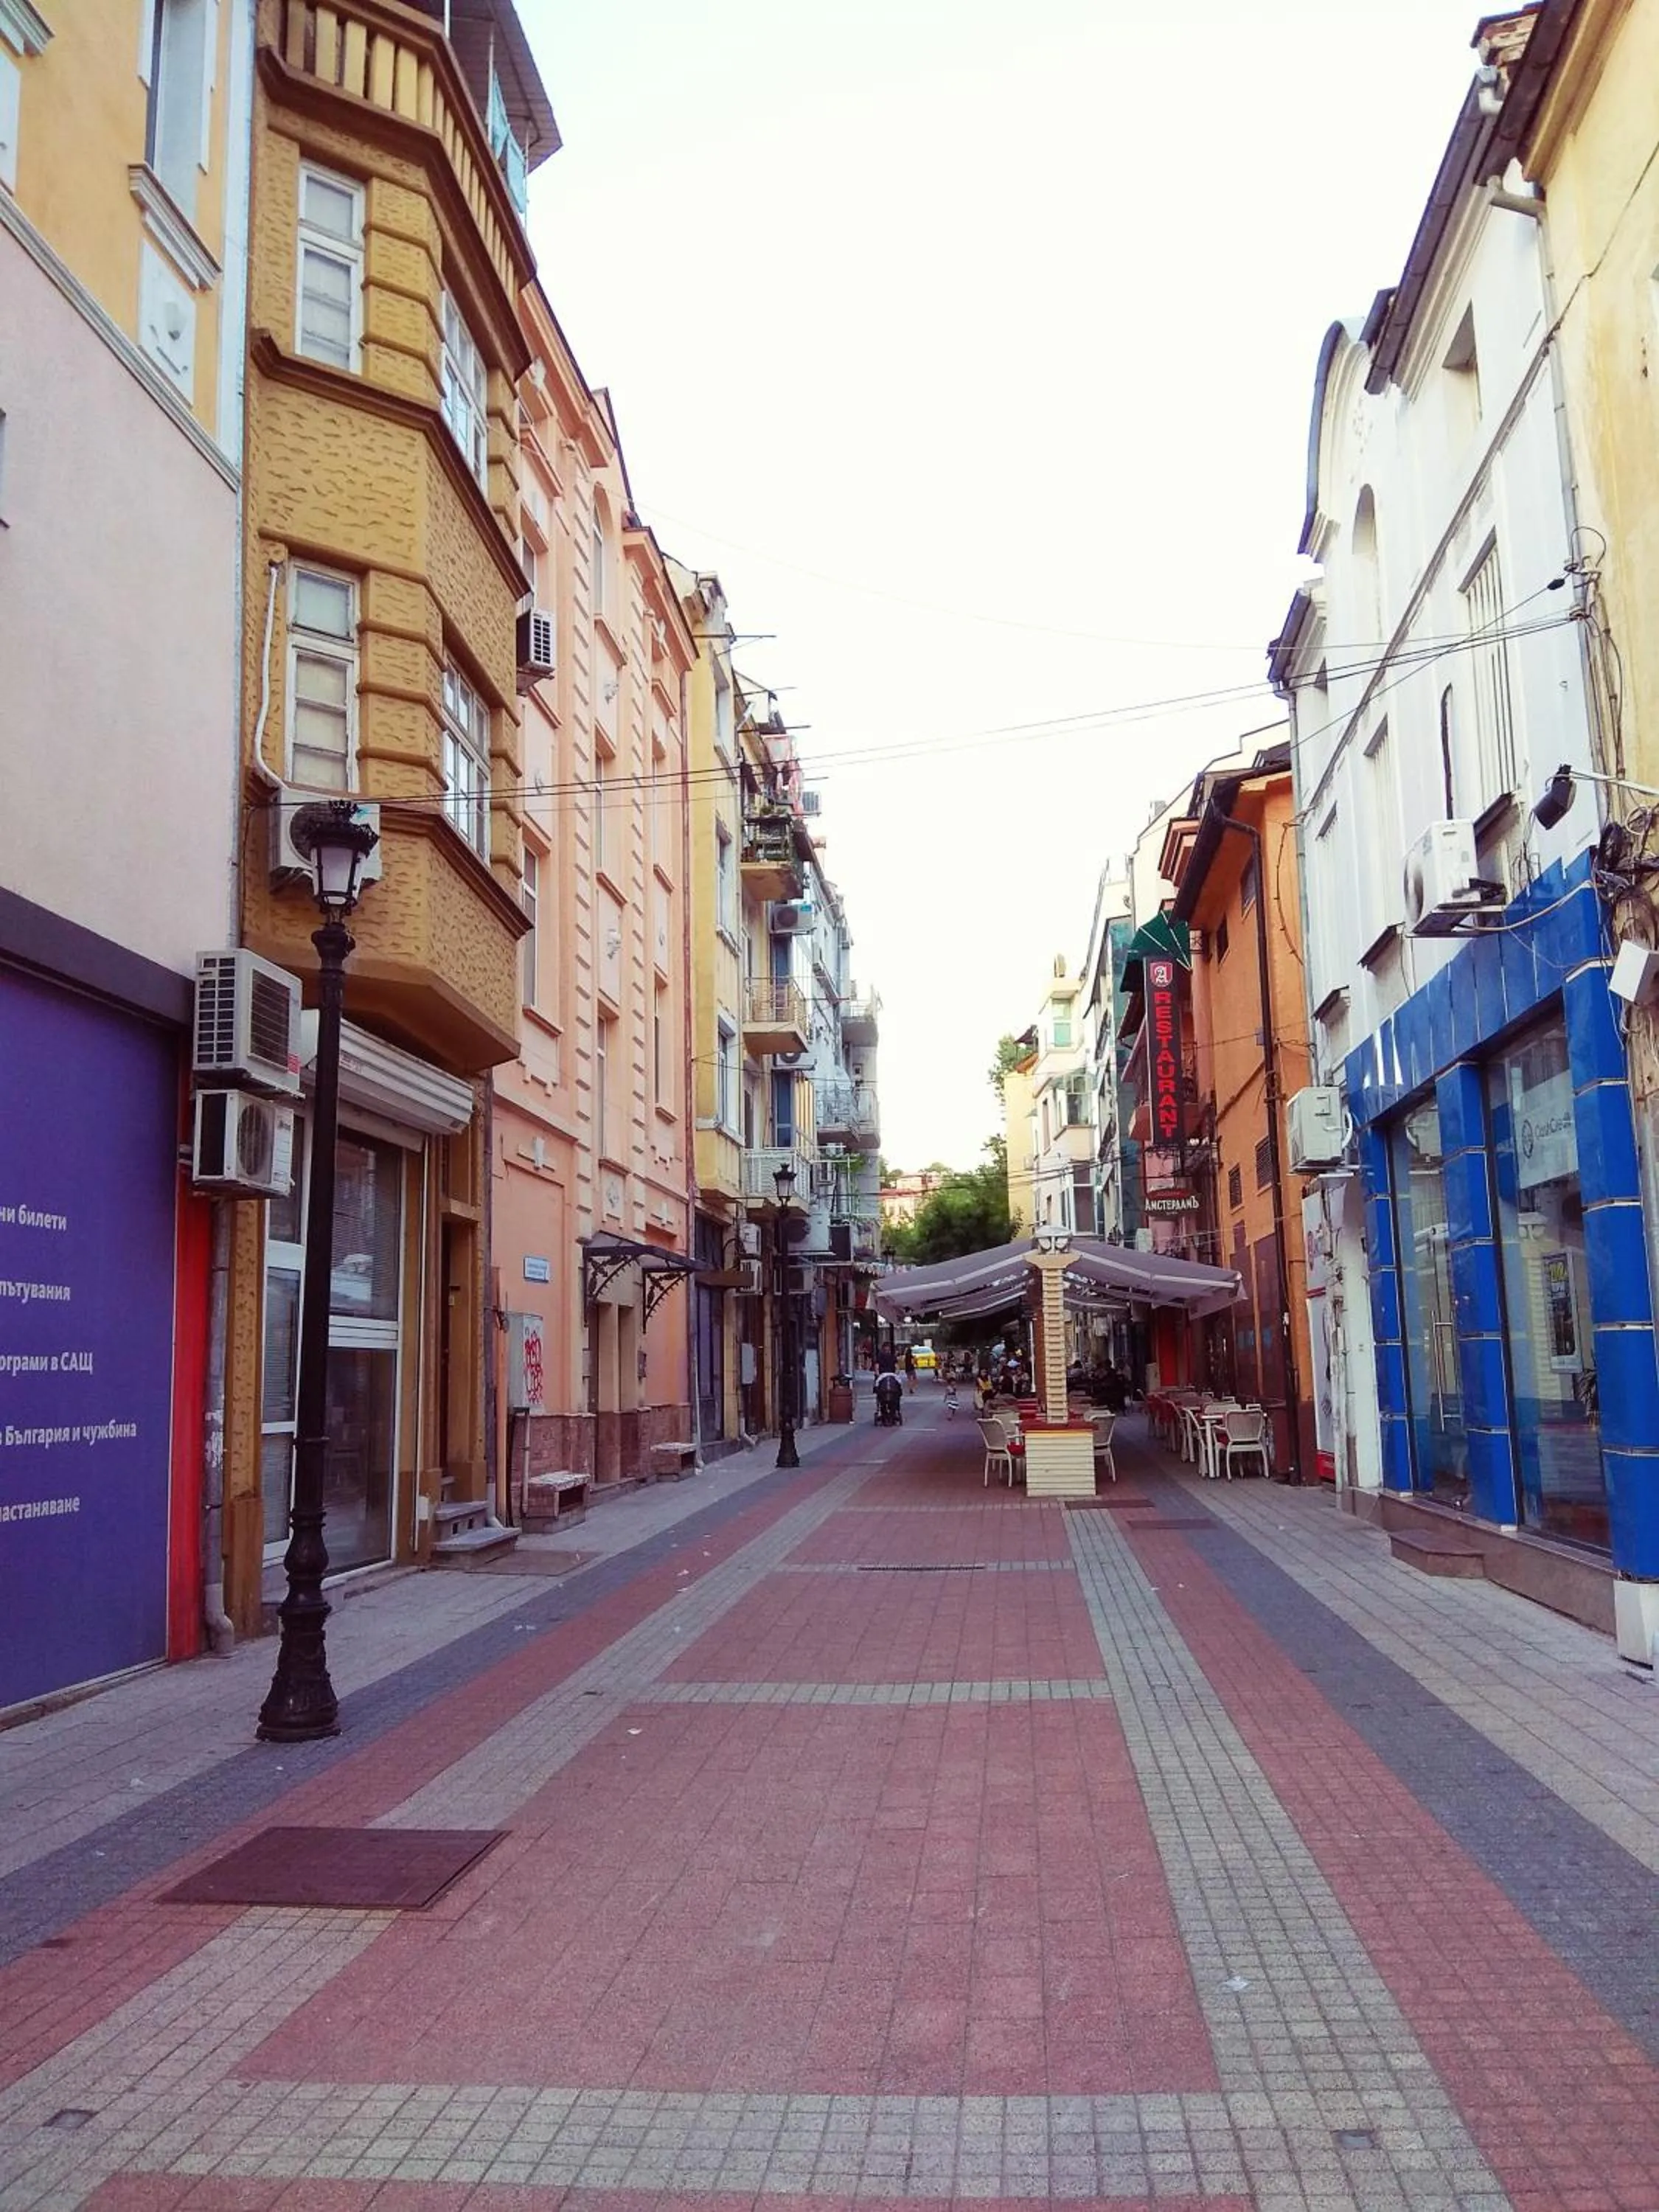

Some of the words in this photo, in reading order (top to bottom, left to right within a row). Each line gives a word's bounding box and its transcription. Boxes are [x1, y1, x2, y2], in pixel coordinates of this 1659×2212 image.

[1153, 991, 1178, 1138] RESTAURANT
[18, 1204, 67, 1231] билети
[0, 1280, 71, 1304] пътувания
[50, 1356, 58, 1371] в
[60, 1352, 93, 1375] САЩ
[5, 1425, 70, 1449] България
[72, 1427, 80, 1441] и
[83, 1419, 136, 1446] чужбина
[0, 1496, 80, 1523] астаняване
